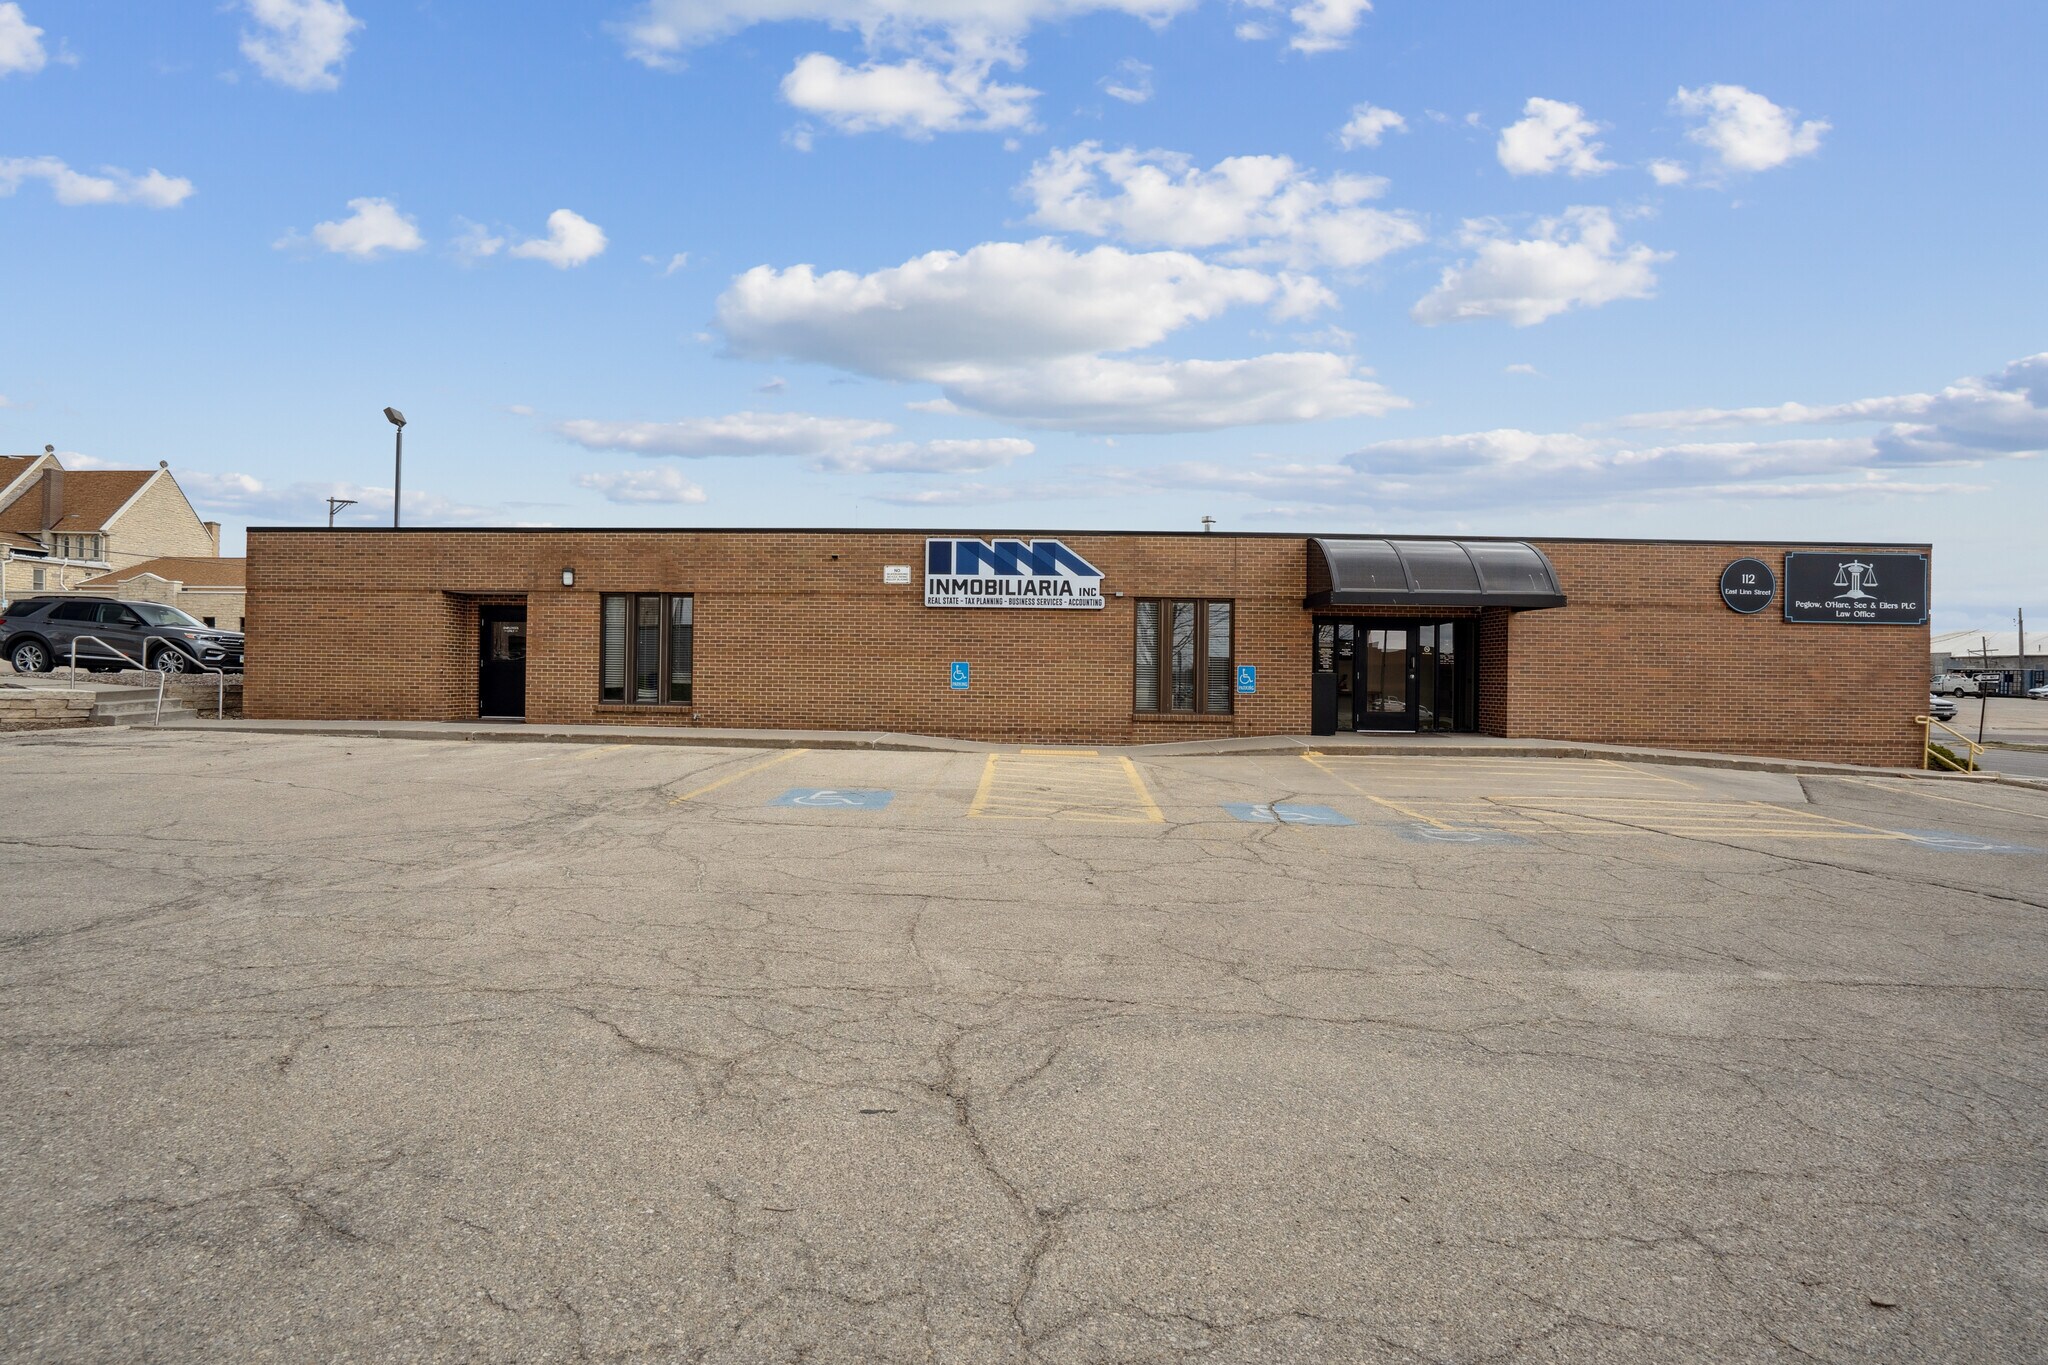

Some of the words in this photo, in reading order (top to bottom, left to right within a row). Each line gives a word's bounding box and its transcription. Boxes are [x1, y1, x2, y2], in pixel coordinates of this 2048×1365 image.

[1742, 574, 1755, 584] 112
[929, 579, 1073, 596] INMOBILIARIA
[1079, 587, 1097, 596] INC
[928, 597, 941, 605] REAL
[943, 597, 959, 605] STATE
[965, 597, 975, 605] TAX
[976, 597, 1003, 605] PLANNING
[1009, 597, 1035, 606] BUSINESS
[1036, 597, 1062, 606] SERVICES
[1068, 598, 1102, 607] ACCOUNTING
[1795, 600, 1822, 609] Peglow,
[1825, 601, 1851, 609] O'Hare,
[1853, 601, 1867, 609] See
[1901, 602, 1916, 610] PLC
[1853, 610, 1876, 618] Office
